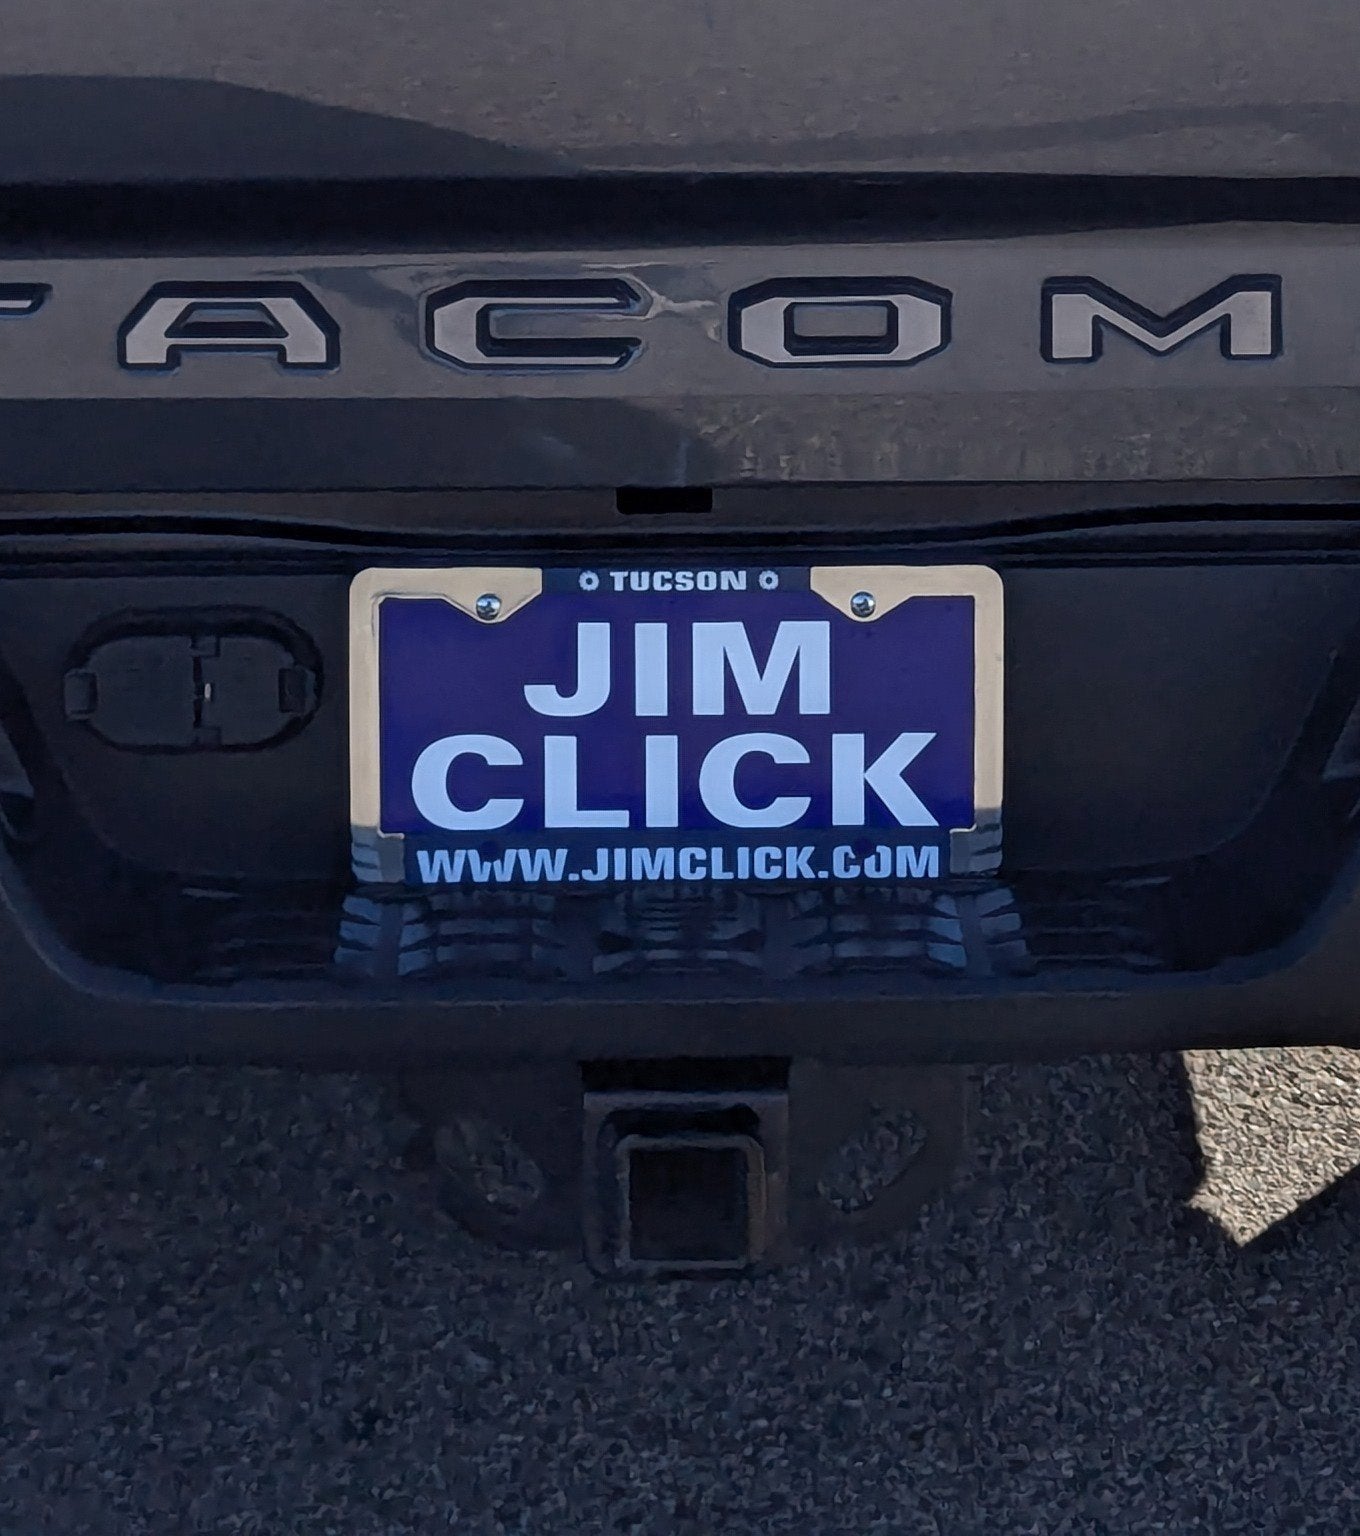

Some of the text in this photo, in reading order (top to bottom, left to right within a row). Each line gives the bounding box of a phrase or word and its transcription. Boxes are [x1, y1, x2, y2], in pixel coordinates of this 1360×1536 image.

[609, 570, 748, 592] TUCSON
[523, 620, 831, 717] JIM
[410, 731, 940, 831] CLICK
[415, 844, 941, 884] WWW.JIMCLICK.COM
